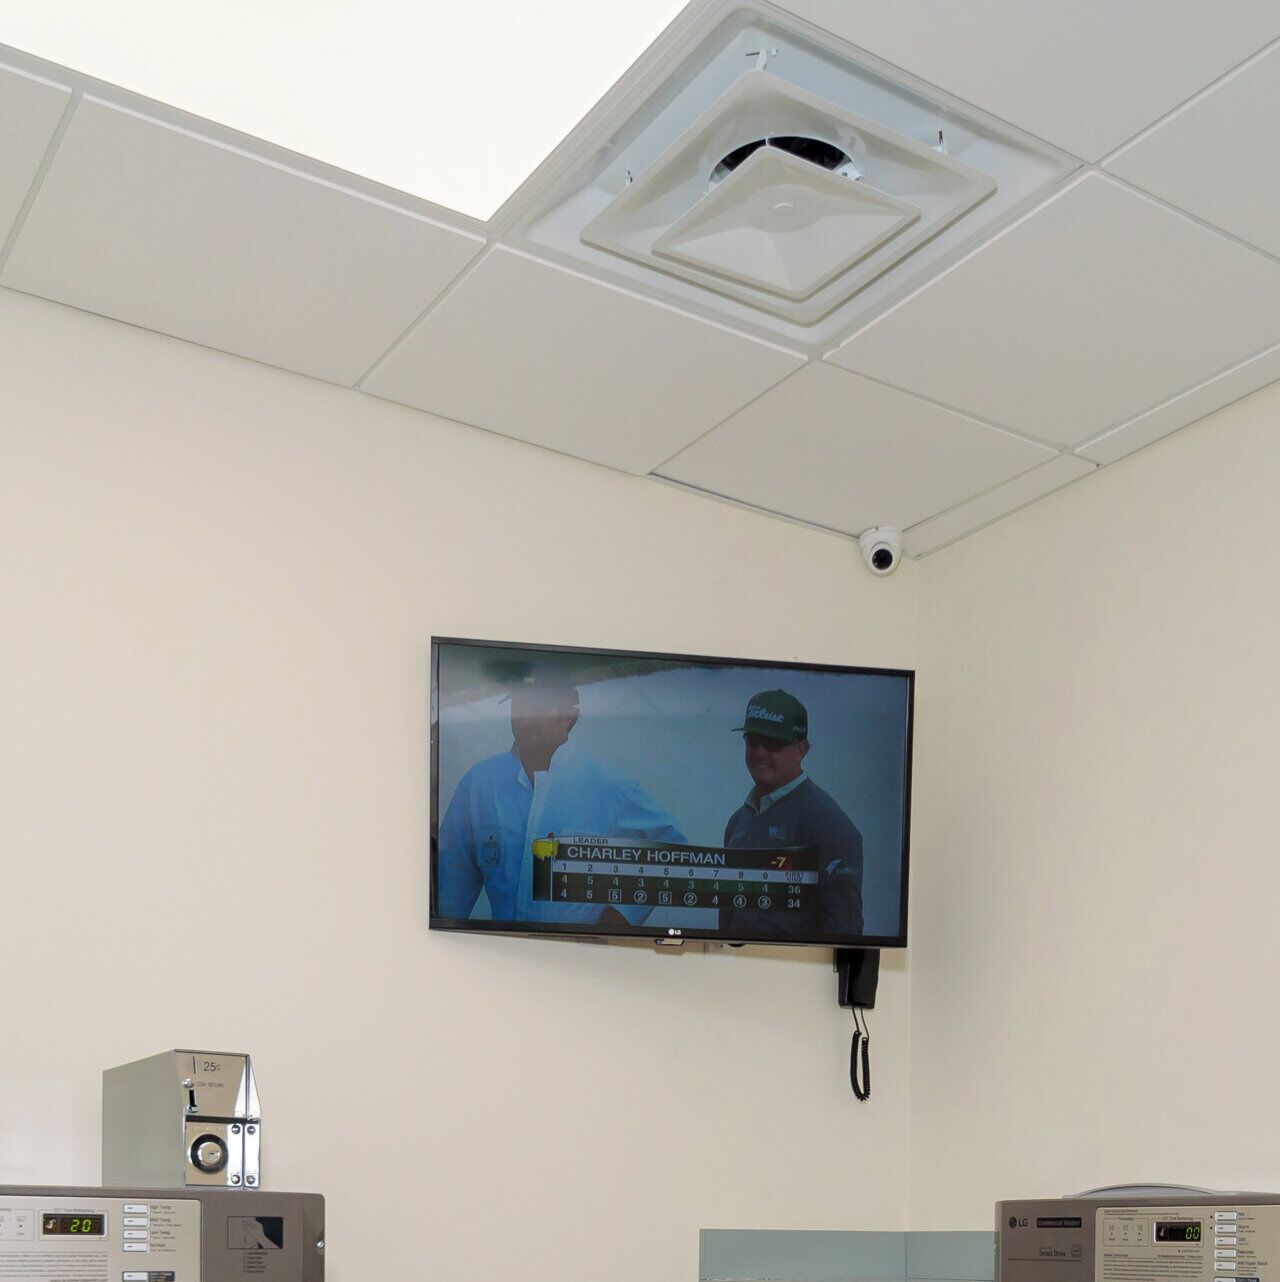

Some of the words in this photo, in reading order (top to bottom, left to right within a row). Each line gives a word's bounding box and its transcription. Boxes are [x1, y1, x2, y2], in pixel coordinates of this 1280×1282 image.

[572, 837, 608, 845] LEADER
[567, 846, 641, 861] CHARLEY
[647, 850, 726, 865] HOFFMAN
[770, 857, 787, 869] -7
[788, 885, 801, 894] 36
[788, 899, 801, 909] 34
[70, 1219, 92, 1233] 20
[1018, 1219, 1028, 1227] LG
[1185, 1226, 1200, 1240] 00
